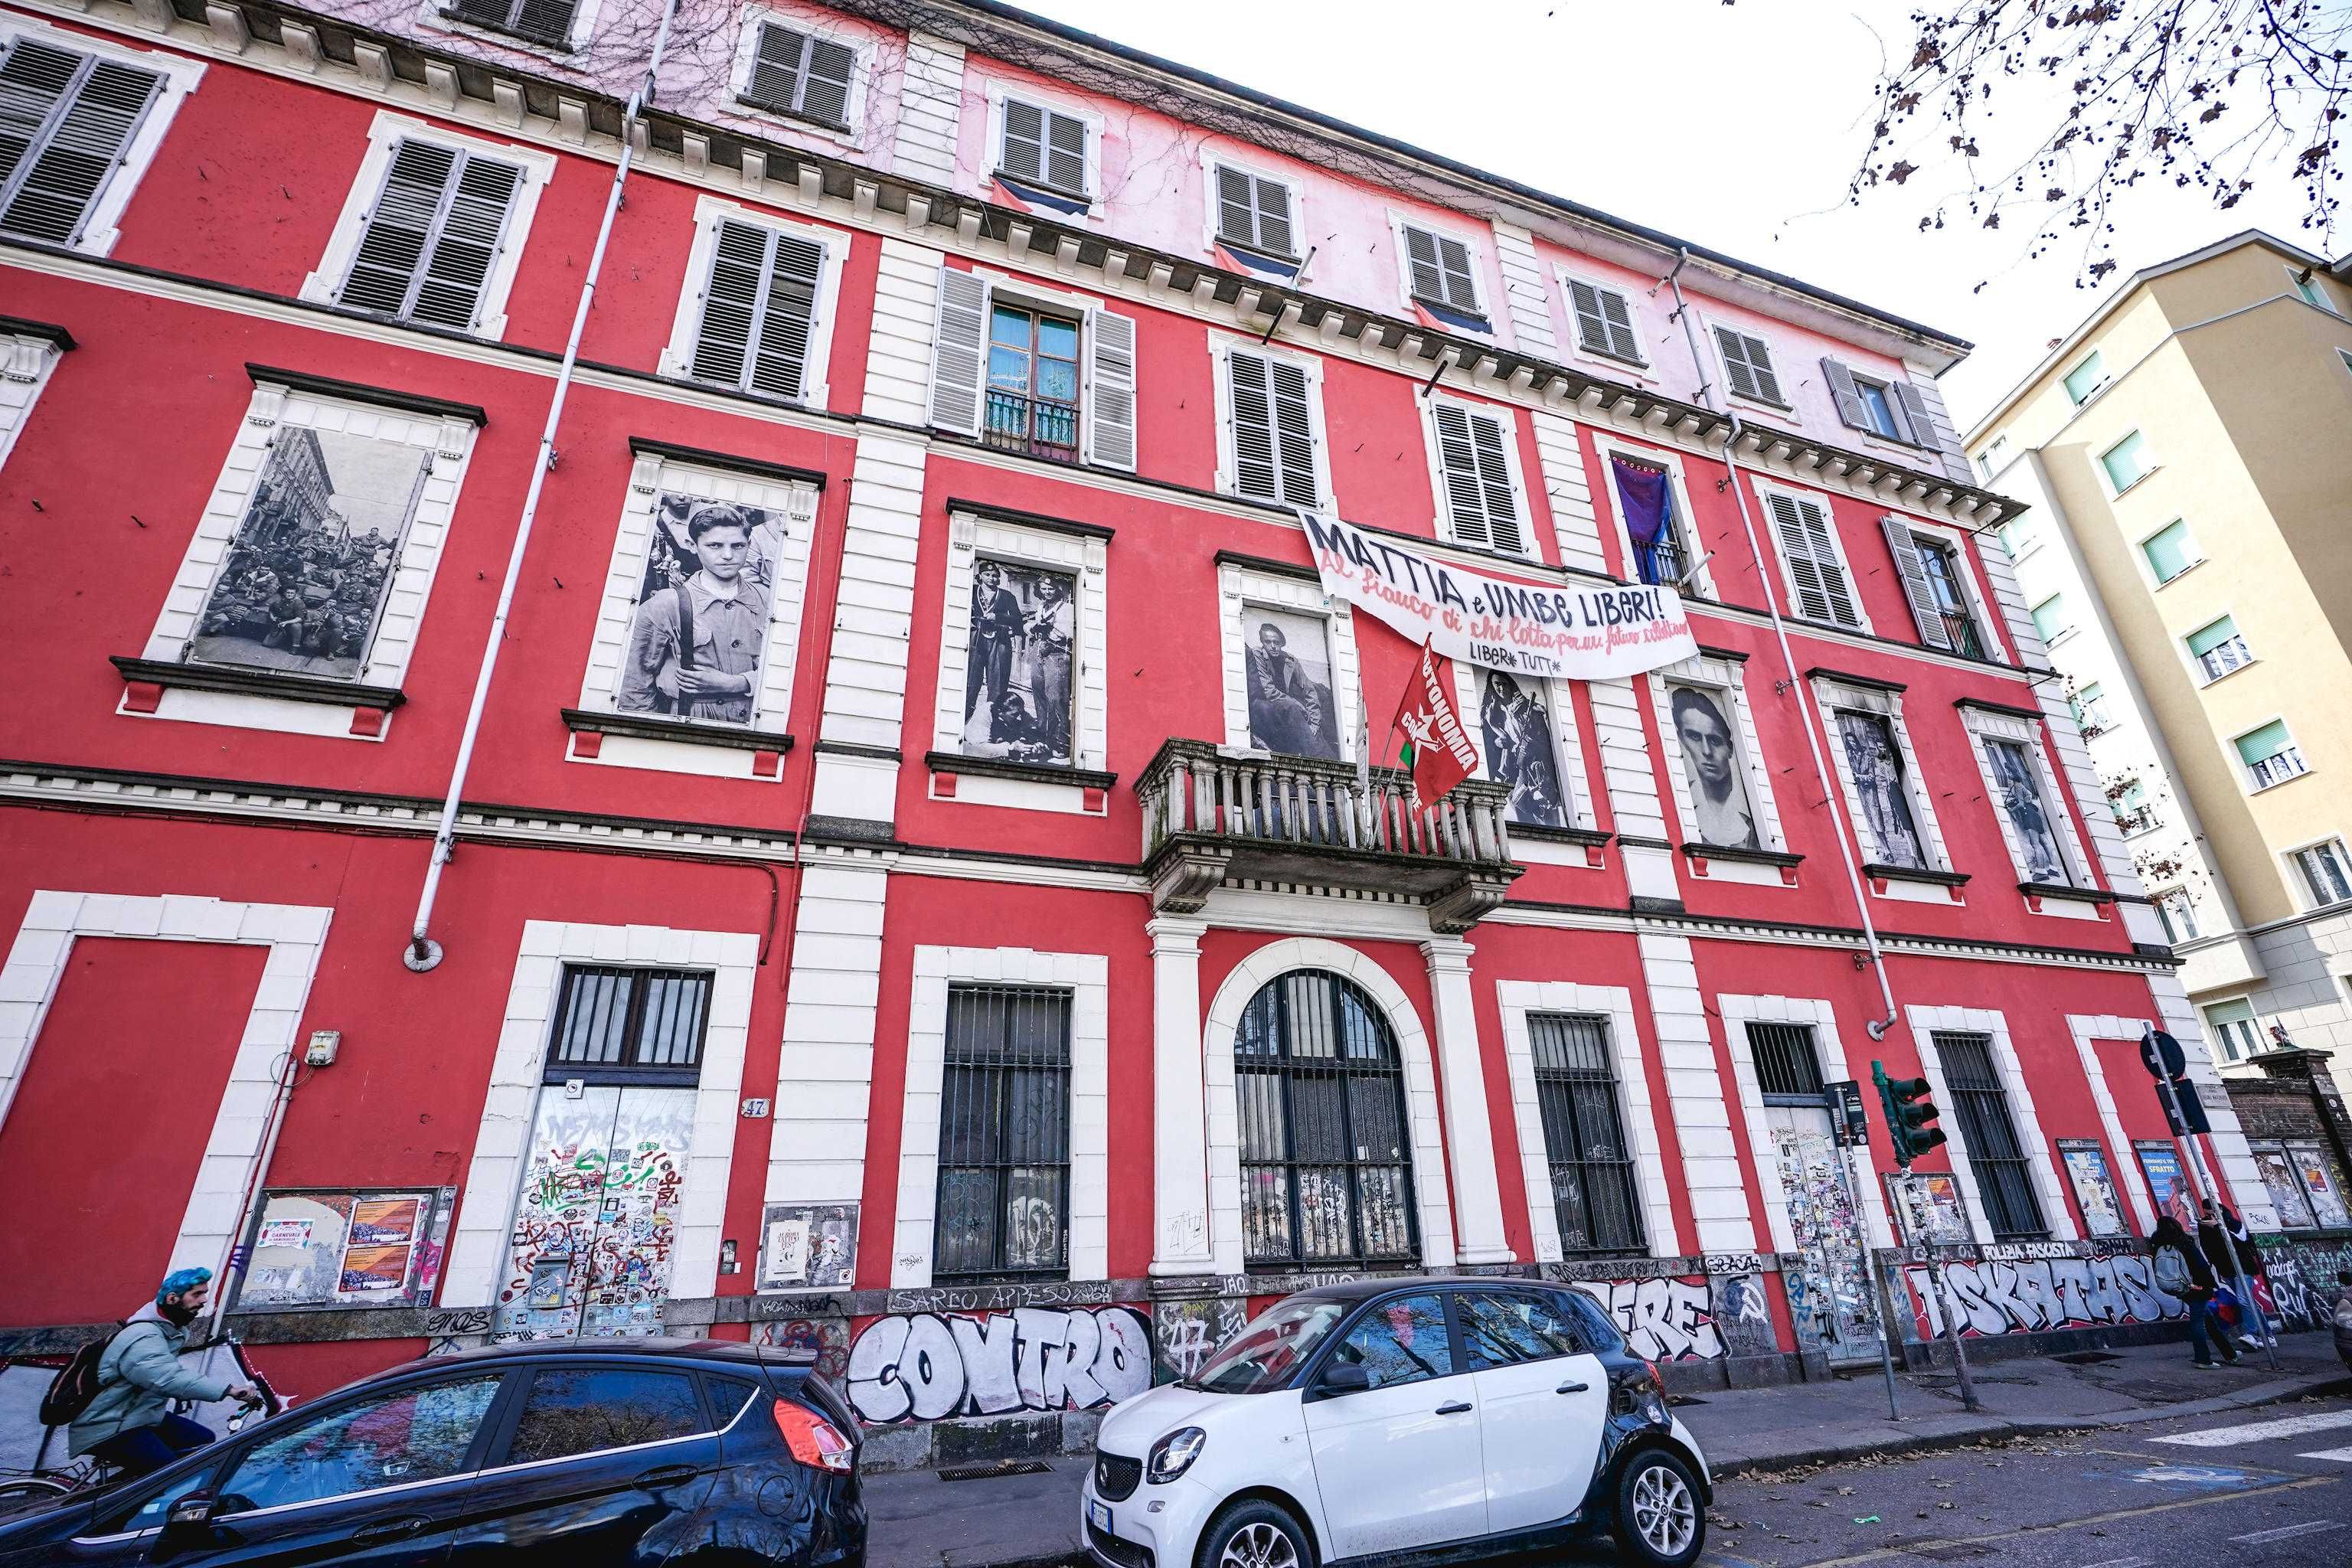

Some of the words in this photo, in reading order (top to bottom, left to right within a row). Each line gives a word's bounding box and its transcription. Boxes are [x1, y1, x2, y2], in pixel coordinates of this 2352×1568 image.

[1304, 514, 1467, 613] MATTIA
[1472, 595, 1485, 614] e
[1484, 583, 1573, 628] UMBE
[1578, 588, 1665, 627] LIBERI!
[1321, 547, 1354, 578] Al
[1442, 610, 1462, 633] di
[1470, 615, 1504, 642] chi
[1507, 615, 1556, 649] lotta
[747, 1101, 765, 1116] 47
[1983, 1245, 2024, 1260] POLIZIA
[2025, 1242, 2076, 1259] FASCISTA
[1908, 1258, 2191, 1340] ASKATASU
[845, 1307, 1155, 1423] CONTRO
